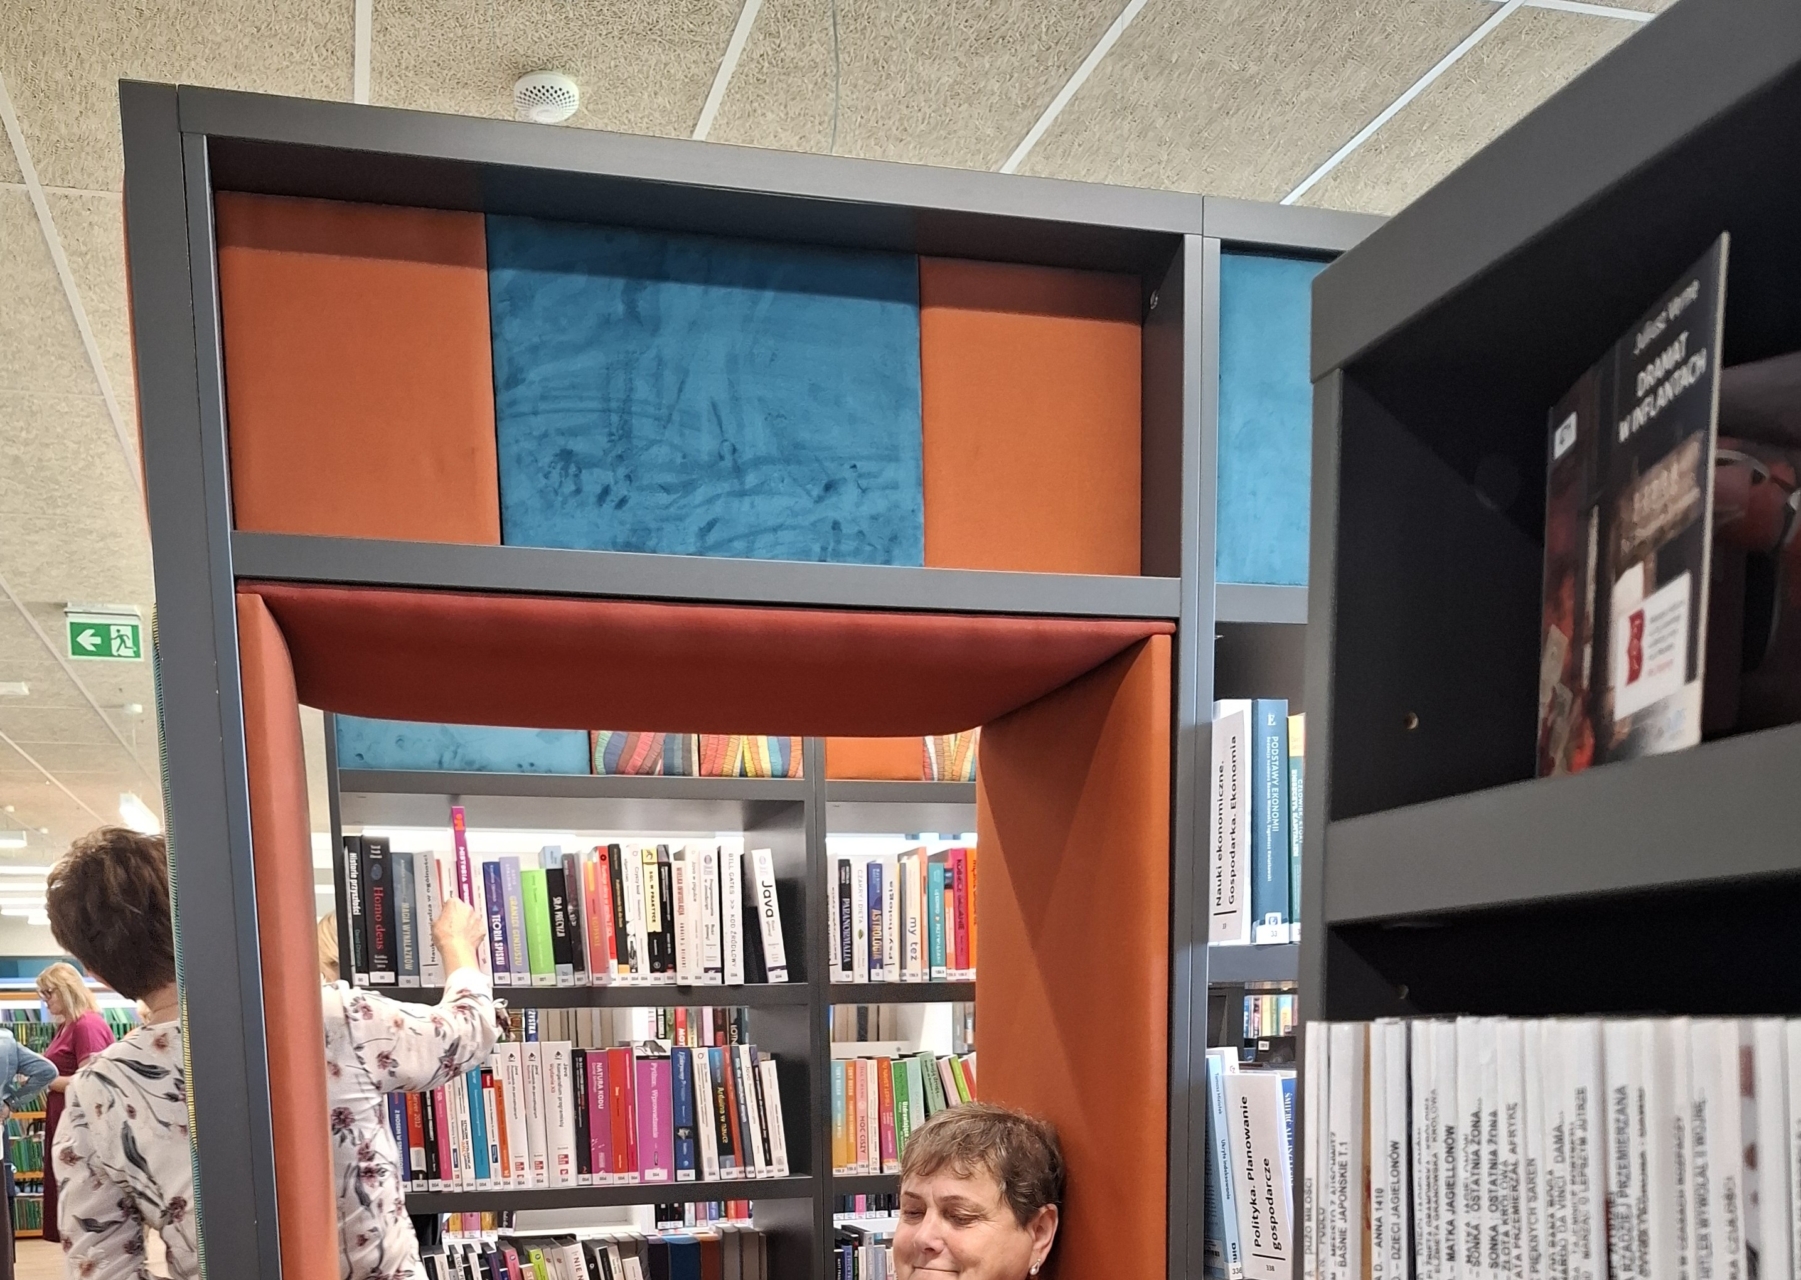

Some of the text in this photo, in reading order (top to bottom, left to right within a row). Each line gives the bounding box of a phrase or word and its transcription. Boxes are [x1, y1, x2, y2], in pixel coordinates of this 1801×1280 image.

[423, 854, 431, 893] ogólności
[459, 847, 467, 882] HISTORIA
[1228, 812, 1237, 904] Gospodarka.
[349, 853, 361, 915] Historie przyszłości
[762, 881, 774, 918] Java
[373, 887, 385, 949] Homo deus
[401, 903, 410, 923] MAGIA
[842, 898, 851, 962] PARANORMALIA
[872, 909, 881, 959] ASTROLOGIA
[402, 925, 413, 970] WYNALAZKÓW
[491, 915, 505, 965] TEORIA SPISKU
[512, 930, 522, 966] GENIUSZU
[908, 917, 919, 961] my też
[597, 1090, 605, 1109] KODU
[649, 1062, 659, 1138] Python. Wprowadzenie
[717, 1087, 726, 1114] Arduino
[1241, 1096, 1261, 1248] Polityka. Planowanie
[1443, 1125, 1456, 1214] JAGIELLONÓW
[1470, 1150, 1481, 1212] OSTATNIA
[1487, 1150, 1498, 1213] OSTATNIA
[1264, 1158, 1282, 1251] gospodarcze
[1337, 1228, 1347, 1267] BAŚNIE
[1374, 1216, 1383, 1248] ANNA
[1389, 1223, 1402, 1260] DZIECI
[1445, 1218, 1456, 1262] MATKA
[1470, 1223, 1481, 1267] SONKA
[1487, 1224, 1499, 1269] SONKA
[1527, 1207, 1541, 1274] PIĘKNYCH
[572, 1257, 584, 1273] NIE
